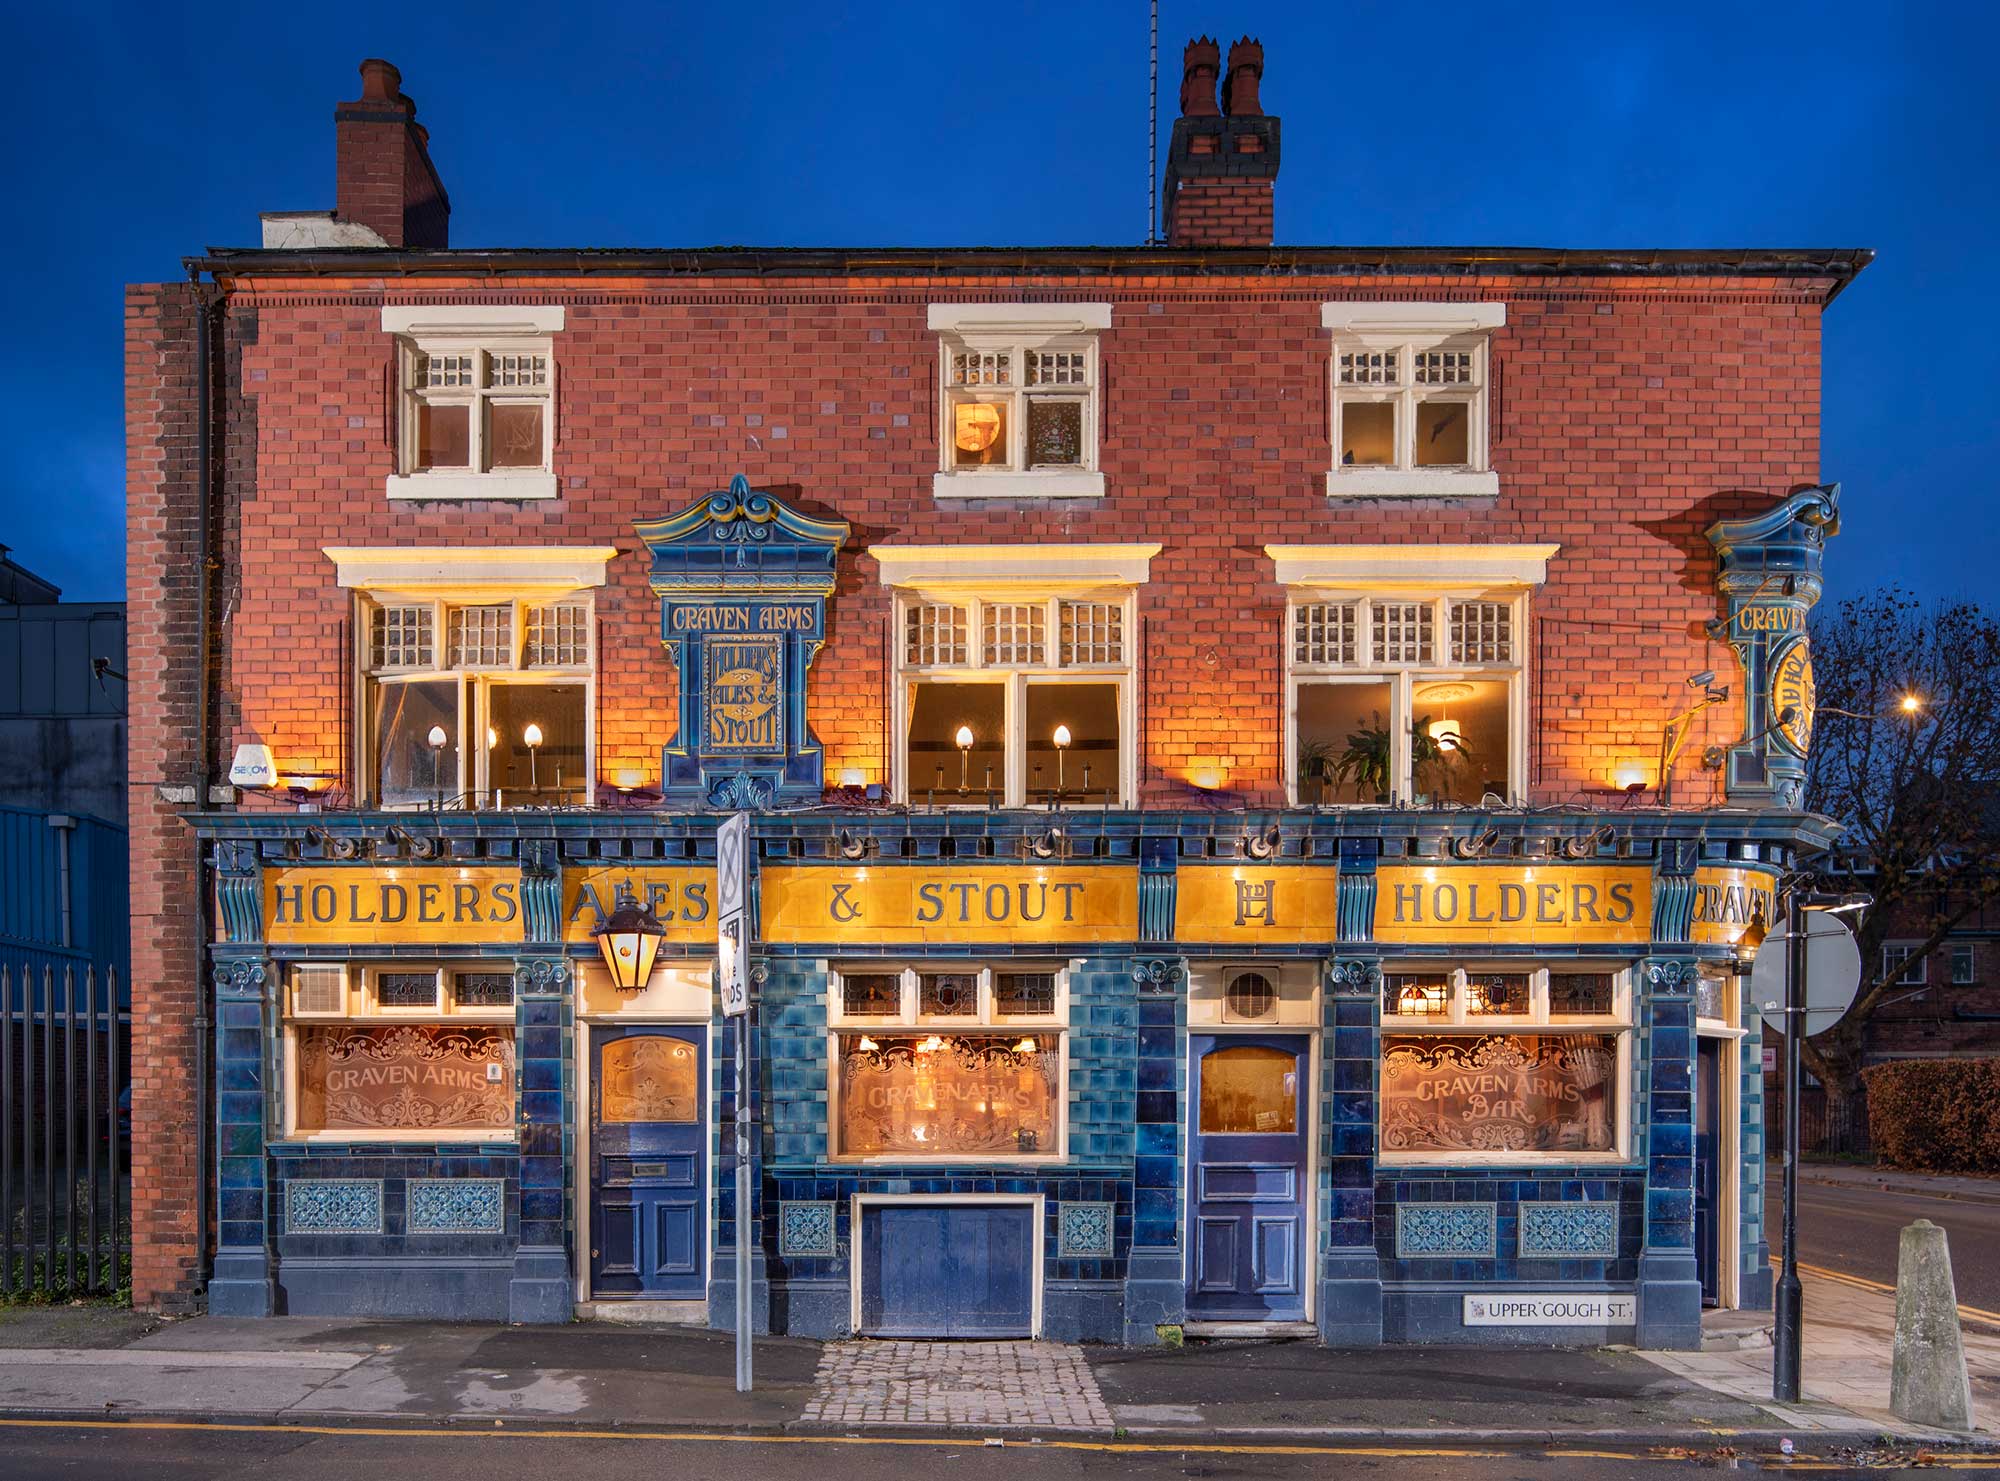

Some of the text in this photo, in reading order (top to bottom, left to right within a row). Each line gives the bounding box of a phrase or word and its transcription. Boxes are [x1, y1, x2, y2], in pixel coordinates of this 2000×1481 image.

[672, 607, 814, 630] CRAVEN ARMS
[712, 646, 775, 684] HOLDERS
[712, 685, 776, 705] ALES &
[712, 706, 775, 744] STOUT
[234, 766, 268, 776] SECOM
[275, 883, 517, 924] HOLDERS
[830, 883, 863, 923] &
[917, 882, 1086, 922] STOUT
[1394, 882, 1636, 923] HOLDERS
[326, 1065, 419, 1092] CRAVEN
[422, 1066, 487, 1091] ARMS
[1416, 1075, 1581, 1102] CRAVEN ARMS
[868, 1082, 1031, 1109] CRAVEN ARMS
[1462, 1094, 1536, 1124] BAR
[1489, 1303, 1538, 1318] UPPER
[1543, 1303, 1601, 1318] GOUGH
